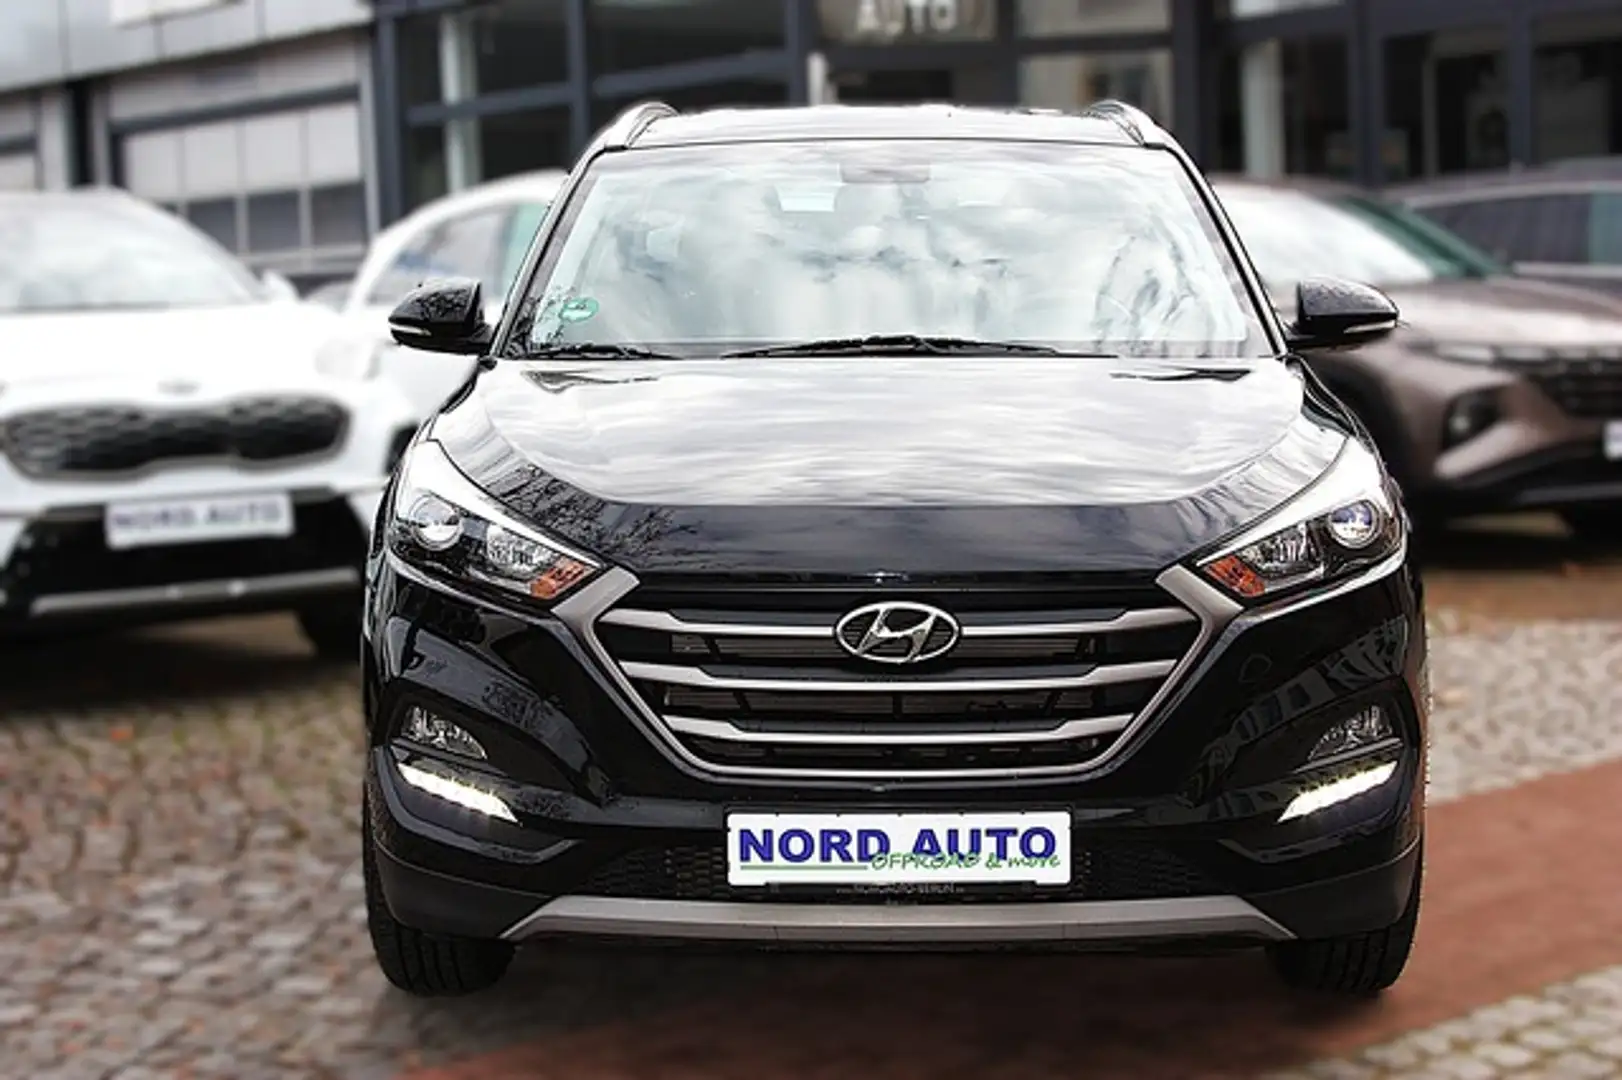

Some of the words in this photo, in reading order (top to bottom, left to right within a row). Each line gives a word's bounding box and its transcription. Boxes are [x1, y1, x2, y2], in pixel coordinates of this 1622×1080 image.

[738, 828, 891, 863] NORD
[911, 826, 1057, 863] AUTO
[985, 851, 1002, 869] &
[1008, 853, 1061, 869] more
